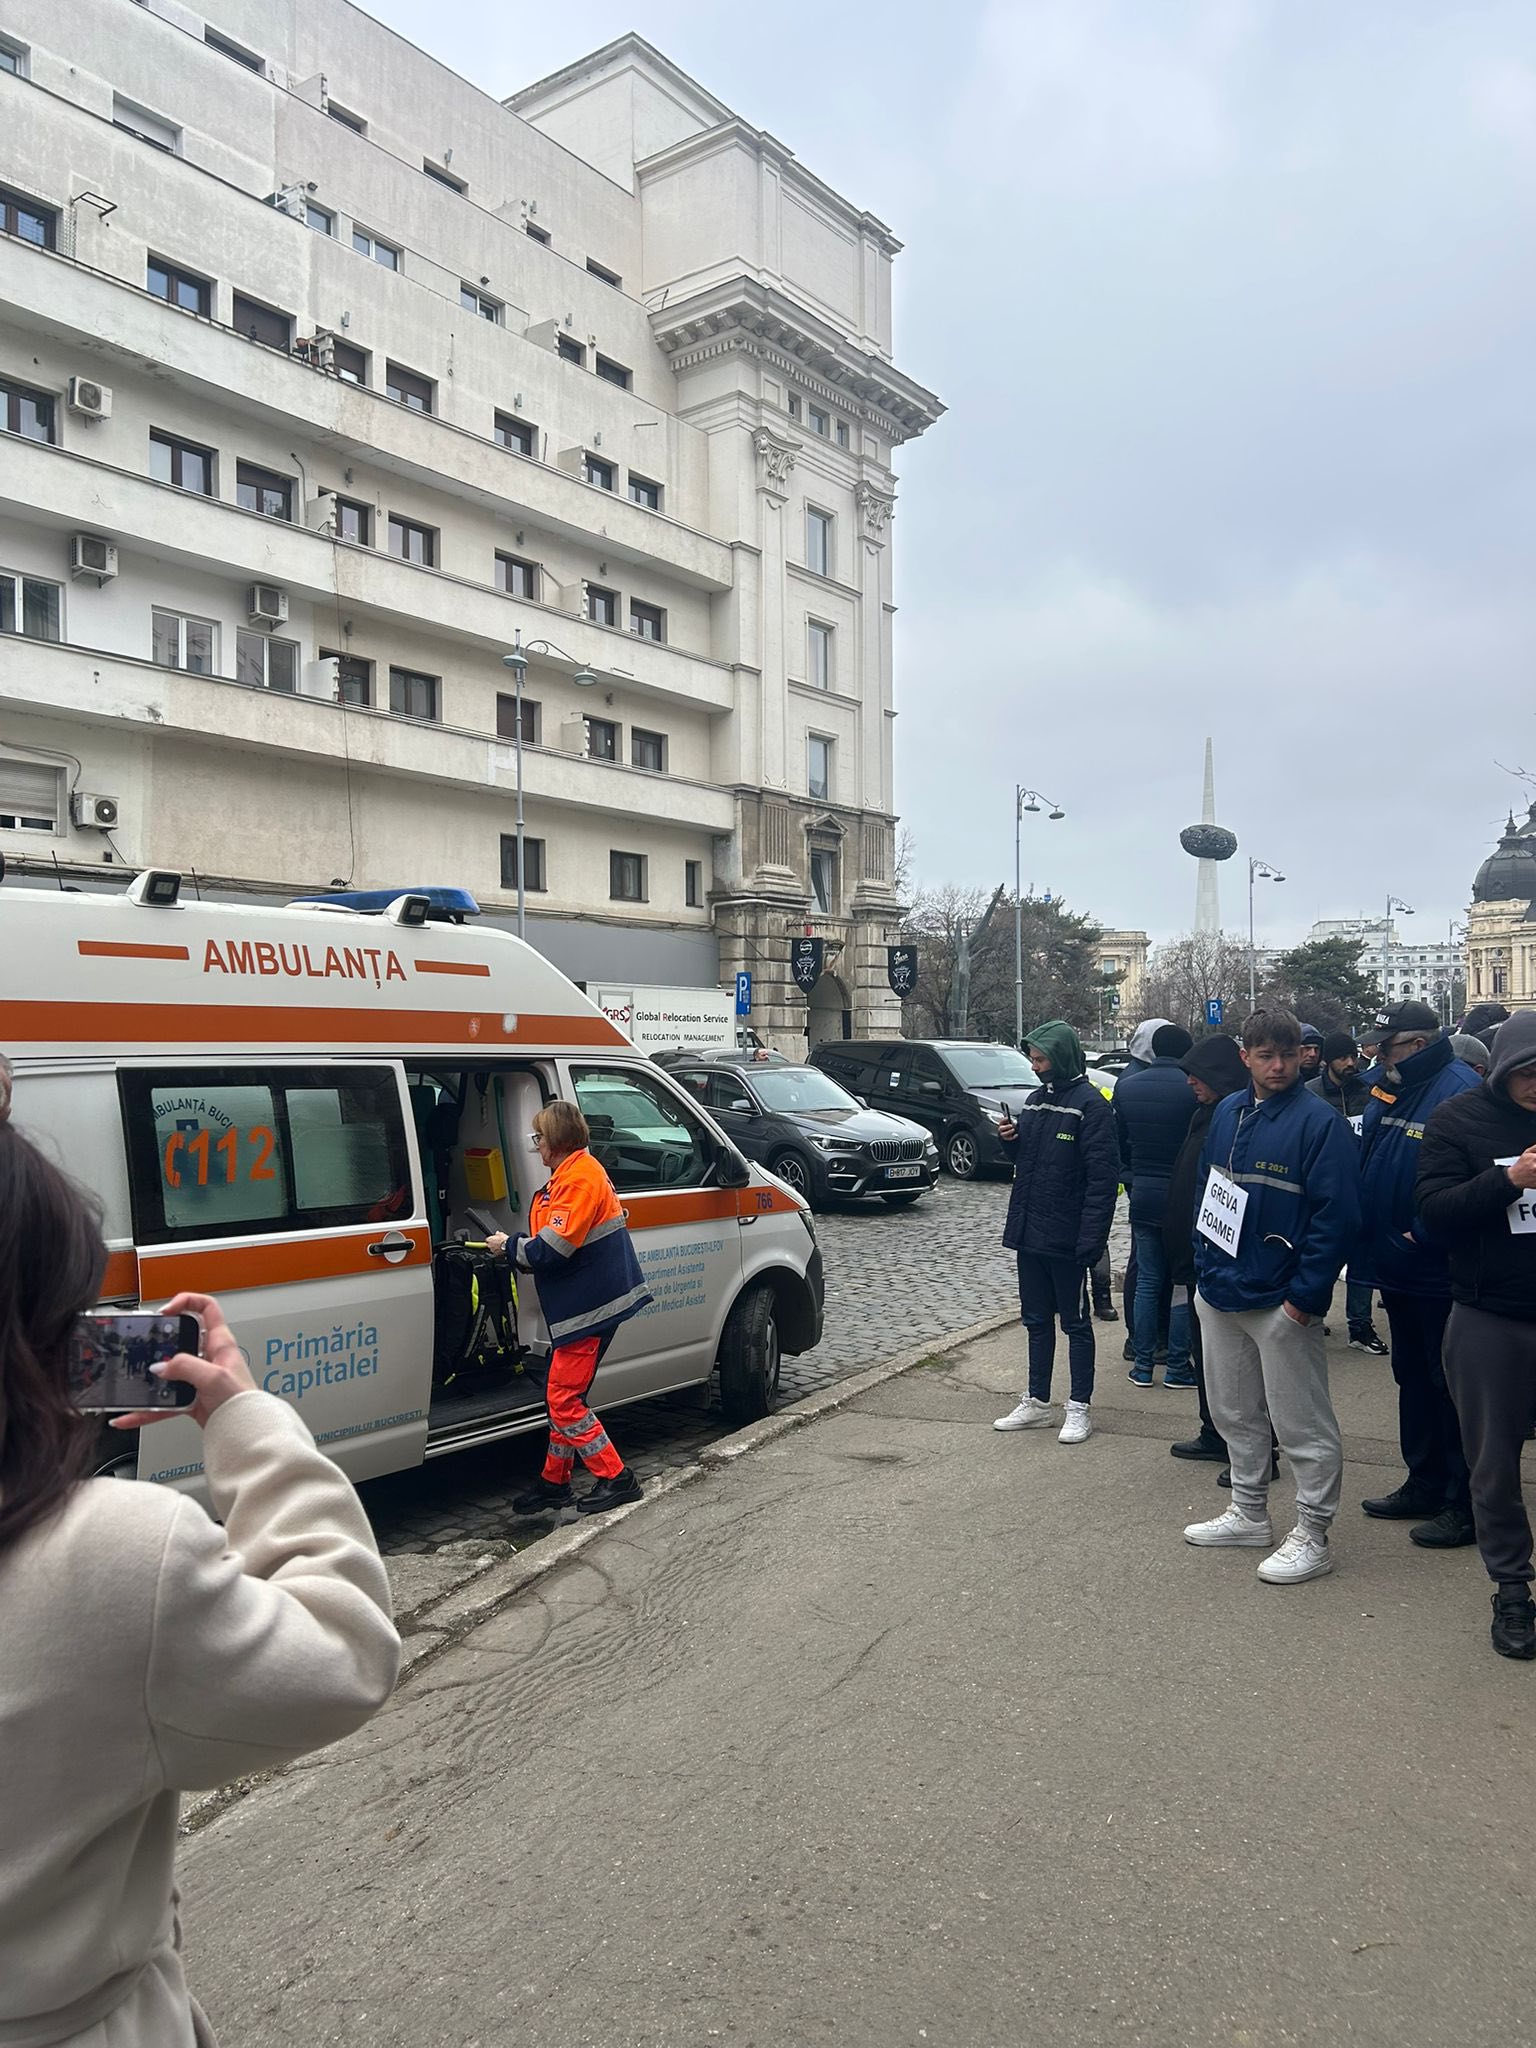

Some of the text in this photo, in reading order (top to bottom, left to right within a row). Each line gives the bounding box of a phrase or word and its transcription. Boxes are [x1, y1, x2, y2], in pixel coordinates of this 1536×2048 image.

[203, 939, 407, 989] AMBULANȚA
[739, 976, 748, 1002] P
[636, 1011, 729, 1023] Global Relocation Service
[1209, 1001, 1218, 1017] P
[641, 1032, 725, 1042] RELOCATION MANAGEMENT
[1255, 1161, 1267, 1170] CE
[756, 1192, 773, 1209] 766
[1211, 1183, 1238, 1214] GREVA
[1202, 1208, 1235, 1244] FOAMEI
[663, 1281, 672, 1293] de
[661, 1296, 685, 1311] Medical
[265, 1321, 378, 1366] Primăria
[263, 1348, 379, 1399] Capitalei
